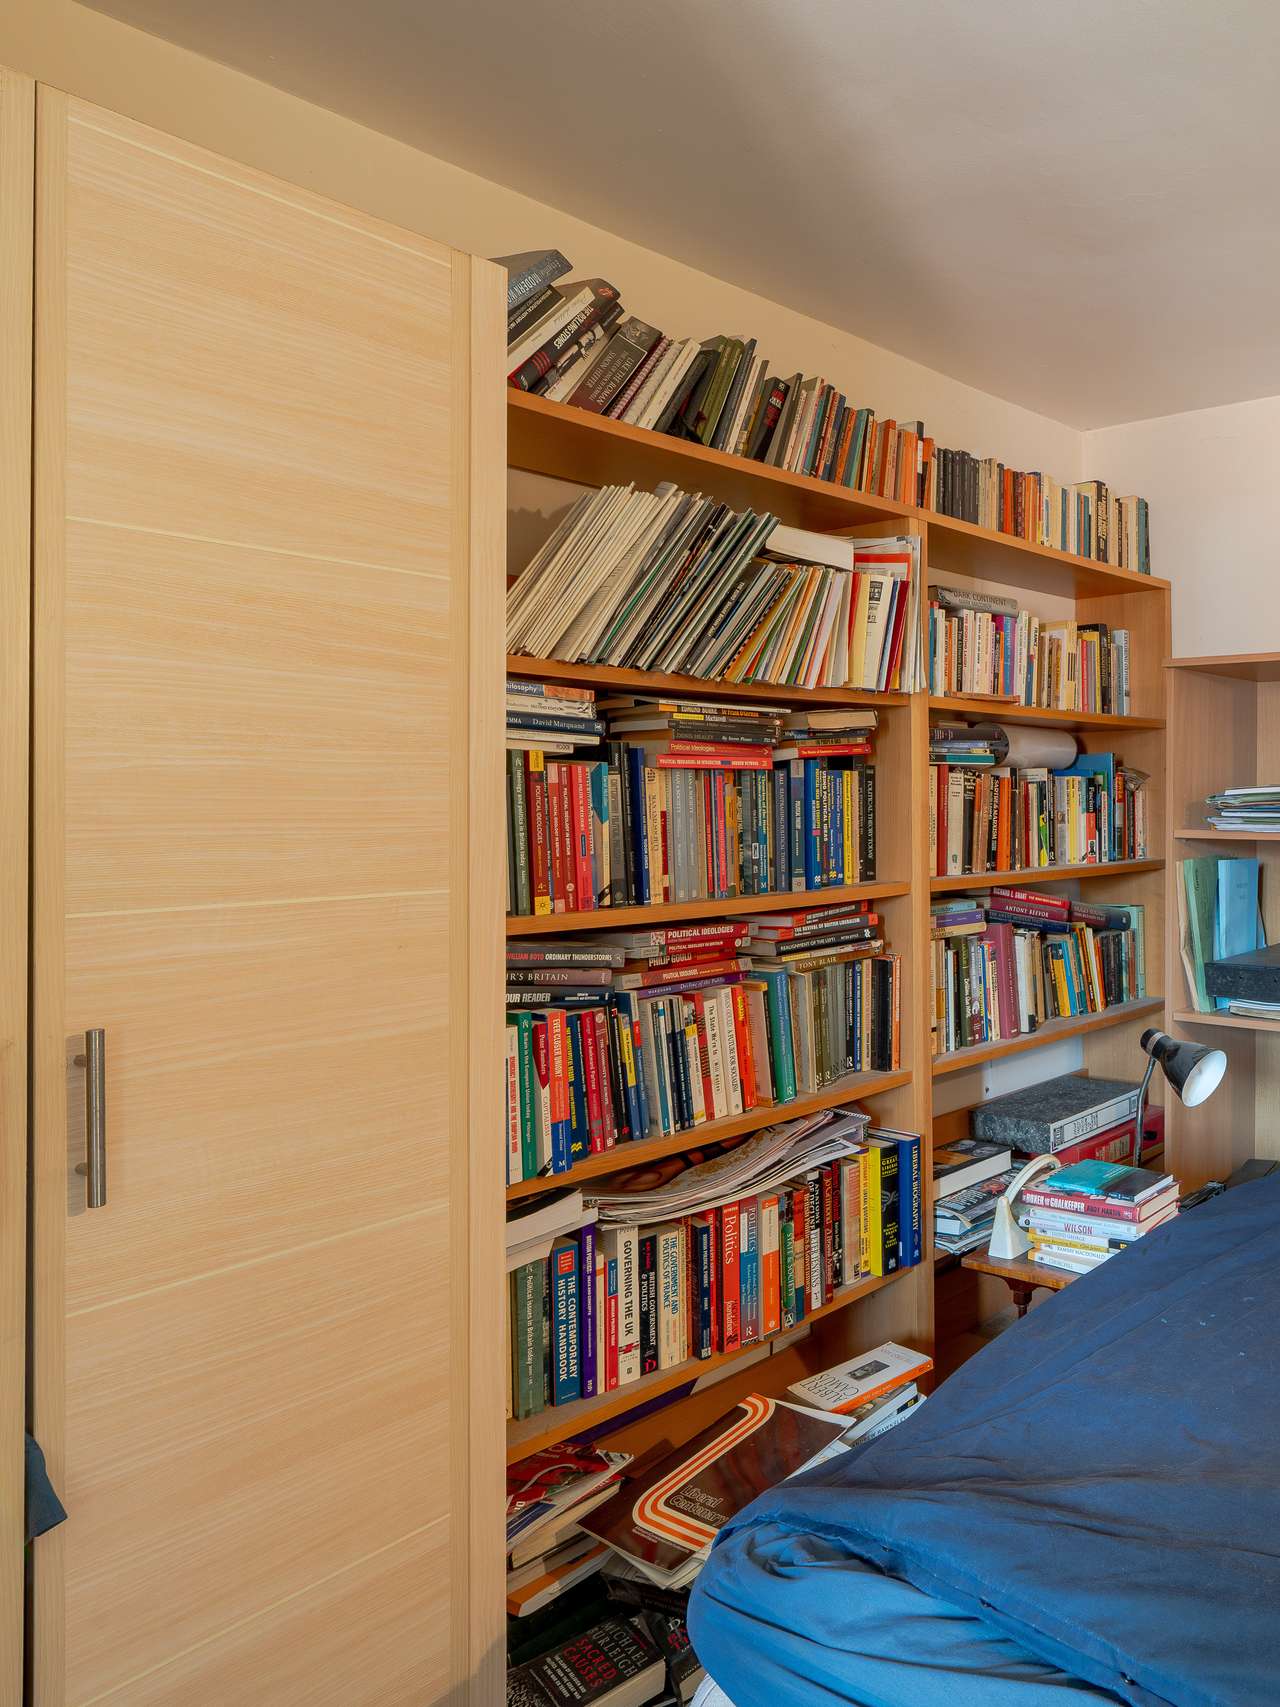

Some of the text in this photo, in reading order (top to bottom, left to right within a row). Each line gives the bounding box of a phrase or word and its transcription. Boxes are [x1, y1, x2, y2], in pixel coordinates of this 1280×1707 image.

[513, 271, 541, 294] MODERN
[553, 305, 594, 350] THE ROLLING STONES
[553, 720, 585, 730] Marquand
[517, 804, 525, 826] politics
[518, 851, 526, 867] today
[1014, 892, 1027, 900] GRANT
[1005, 905, 1049, 918] ANTONY BEEVOR
[667, 925, 734, 939] POLITICAL IDEOLOGIES
[545, 953, 571, 961] ORDINARY
[572, 953, 612, 961] THUNDERSTORMS
[648, 953, 692, 967] PHILIP GOULD
[799, 957, 837, 969] TONY BLAIR
[528, 973, 568, 981] BRITAIN
[680, 981, 697, 990] Decline
[522, 992, 551, 1003] READER
[553, 1017, 563, 1078] EVER CLOSER UNION?
[589, 1070, 597, 1090] Partner
[730, 1066, 738, 1093] SOCIALISM
[881, 1156, 898, 1166] GREAT
[1049, 1197, 1085, 1213] GOALKEEPER
[724, 1215, 737, 1265] Politics
[747, 1207, 756, 1252] POLITICS
[1063, 1223, 1093, 1235] WILSON
[662, 1237, 670, 1270] POLITICS
[1074, 1248, 1106, 1260] MACDONALD
[670, 1236, 679, 1315] THE GOVERNMENT AND
[623, 1240, 634, 1337] GOVERNING THE UK
[641, 1280, 649, 1312] POLITICS
[558, 1279, 568, 1382] HISTORY HANDBOOK
[567, 1275, 578, 1378] THE CONTEMPORARY
[649, 1299, 657, 1346] GOVERNMENT
[526, 1347, 534, 1364] today
[800, 1376, 846, 1403] ALBERT
[819, 1373, 860, 1396] CAMUS
[679, 1484, 724, 1509] Liberal
[589, 1626, 638, 1678] BURLEIGH
[602, 1622, 649, 1667] MICHAEL
[563, 1647, 604, 1688] CAUSES
[575, 1637, 618, 1681] SACRED
